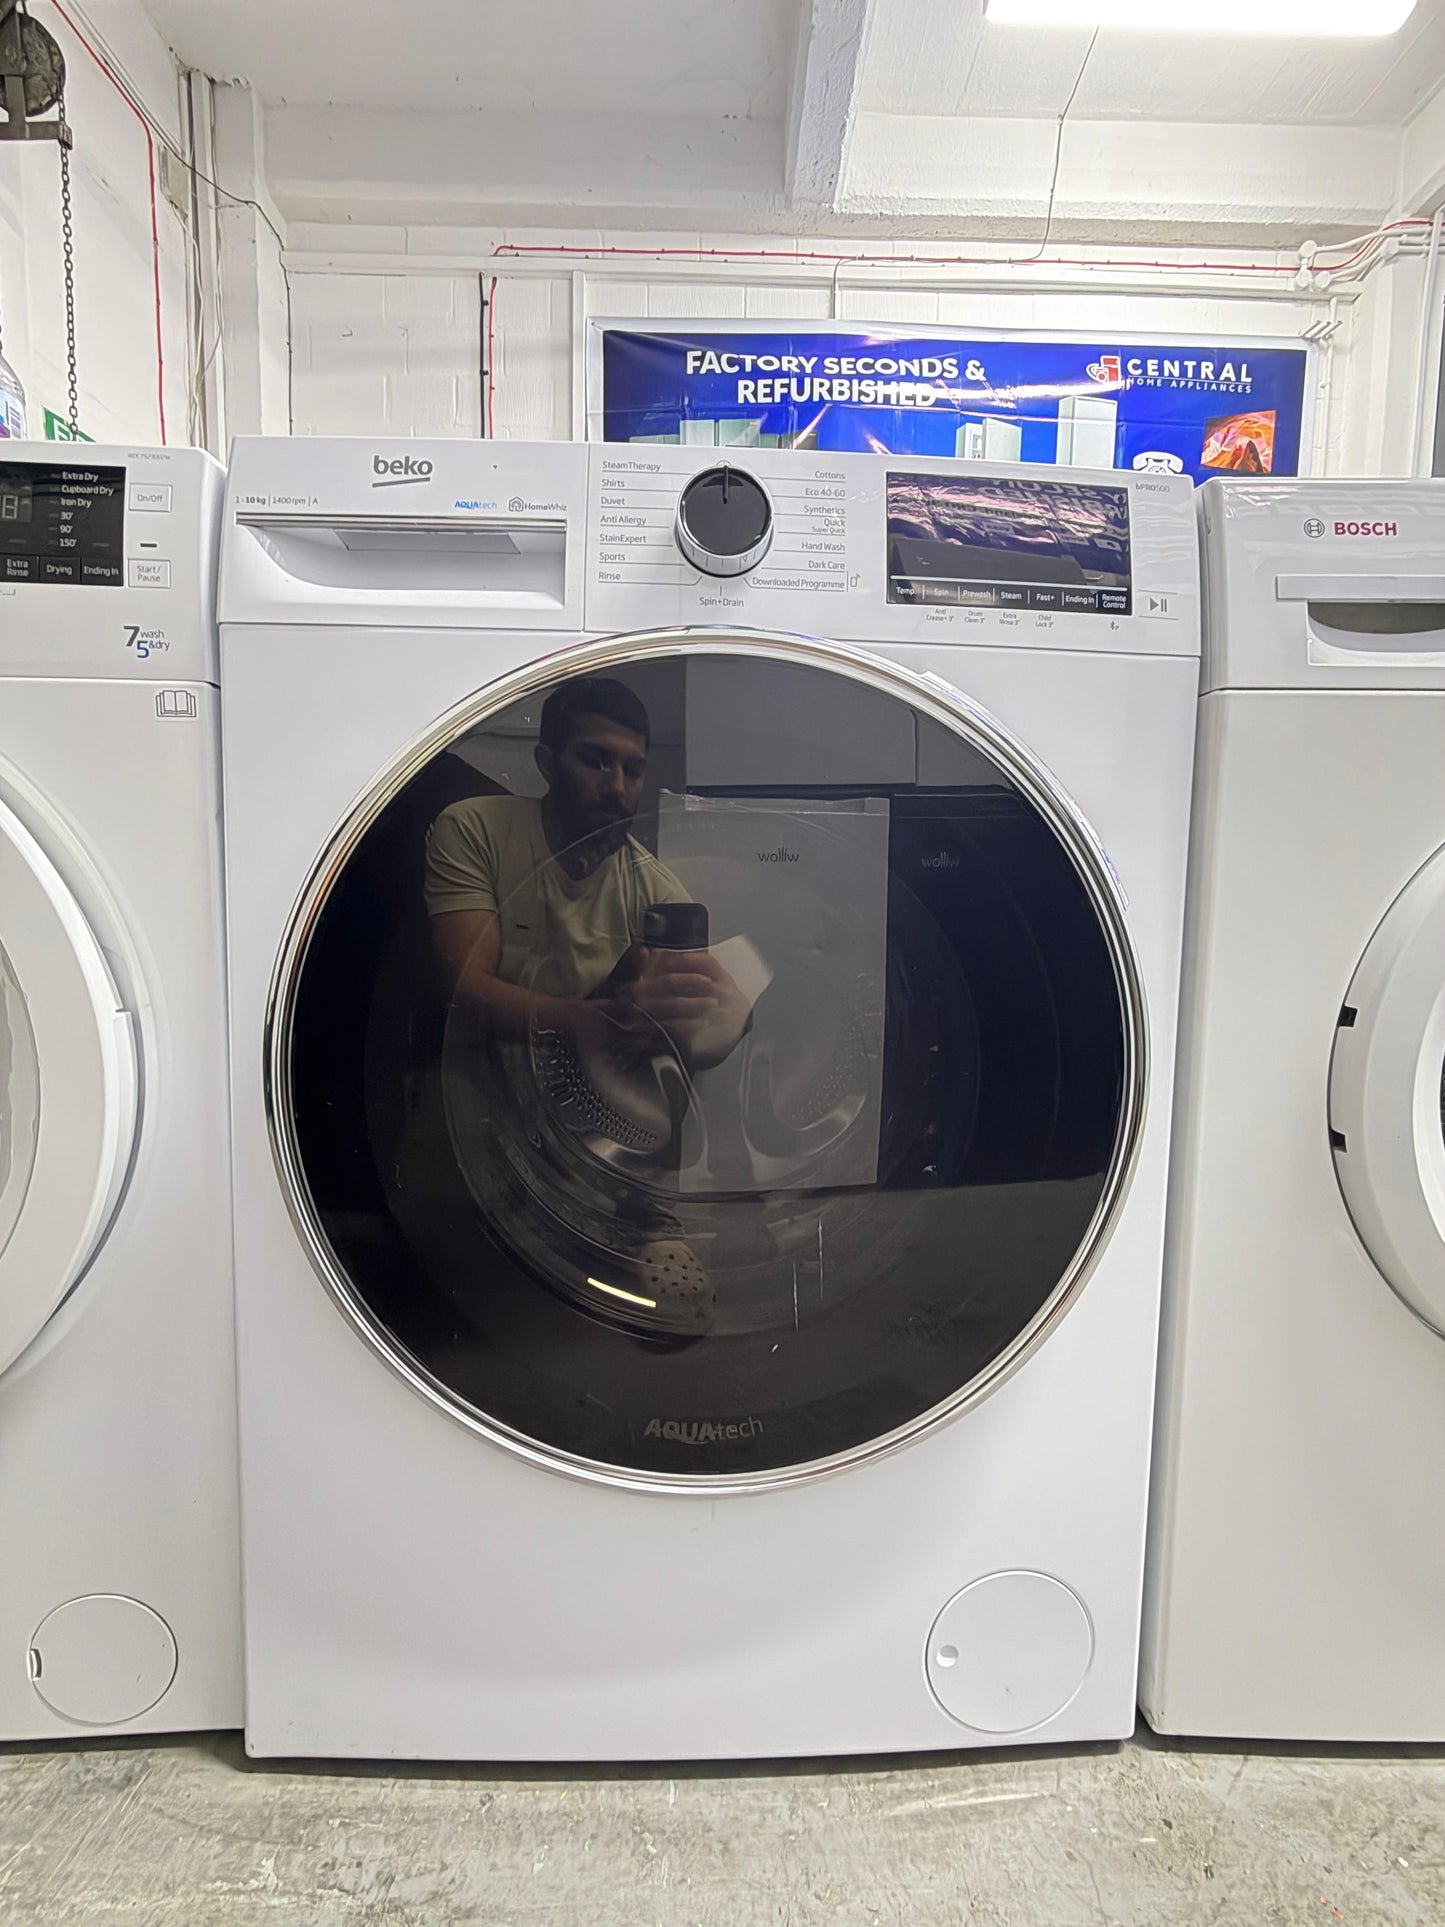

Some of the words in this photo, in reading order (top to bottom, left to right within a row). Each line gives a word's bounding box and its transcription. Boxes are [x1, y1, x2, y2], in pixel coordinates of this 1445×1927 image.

[686, 350, 819, 375] FACTORY
[823, 356, 959, 379] SECONDS
[965, 359, 987, 381] &
[1127, 358, 1253, 383] CENTRAL
[1128, 377, 1162, 388] HOME
[1170, 379, 1252, 394] APPLIANCES
[737, 377, 937, 407] REFURBISHED
[372, 455, 434, 476] beko
[602, 460, 661, 472] SteamTherapy
[61, 471, 83, 481] Extra
[84, 472, 99, 483] Dry
[814, 470, 846, 480] Cottons
[601, 478, 625, 488] Shirts
[61, 484, 99, 494] Cupboard
[99, 485, 114, 496] Dry
[805, 487, 820, 496] Eco
[820, 488, 846, 497] 40-60
[60, 497, 76, 506] Iron
[77, 498, 92, 508] Dry
[136, 494, 163, 502] On/Off
[256, 496, 266, 505] kg
[273, 496, 292, 505] 1400
[292, 497, 306, 506] rpm
[312, 497, 319, 505] A
[600, 496, 625, 505] Duvet
[454, 500, 498, 510] AQUAtech
[525, 502, 567, 511] HomeWhiz
[803, 505, 846, 515] Synthetics
[600, 515, 617, 523] Anti
[618, 515, 647, 527] Allergy
[824, 518, 846, 527] Quick
[811, 526, 828, 534] Super
[829, 526, 846, 534] Quick
[1334, 521, 1398, 536] BOSCH
[599, 533, 647, 544] StainExpert
[801, 541, 822, 550] Hand
[823, 542, 846, 551] Wash
[599, 552, 626, 562] Sports
[6, 558, 28, 567] Extra
[808, 560, 827, 569] Dark
[827, 561, 846, 569] Care
[6, 568, 29, 577] Rinse
[46, 564, 73, 576] Drying
[83, 565, 110, 577] Ending
[111, 567, 119, 576] In
[136, 564, 161, 573] Start/
[137, 573, 161, 582] Pause
[598, 571, 621, 580] Rinse
[752, 576, 800, 586] Downloaded
[800, 578, 845, 590] Programme
[934, 587, 949, 597] Spin
[962, 589, 991, 599] Prewash
[1000, 591, 1022, 600] Steam
[1036, 593, 1055, 601] Fast+
[699, 596, 744, 607] Spin+Drain
[1065, 594, 1088, 605] Ending
[1088, 596, 1095, 604] In
[1101, 593, 1127, 602] Remote
[1102, 601, 1126, 609] Control
[123, 625, 140, 647] 7
[140, 629, 165, 639] wash
[136, 640, 150, 659] 5
[643, 1416, 764, 1446] AQUAtech
